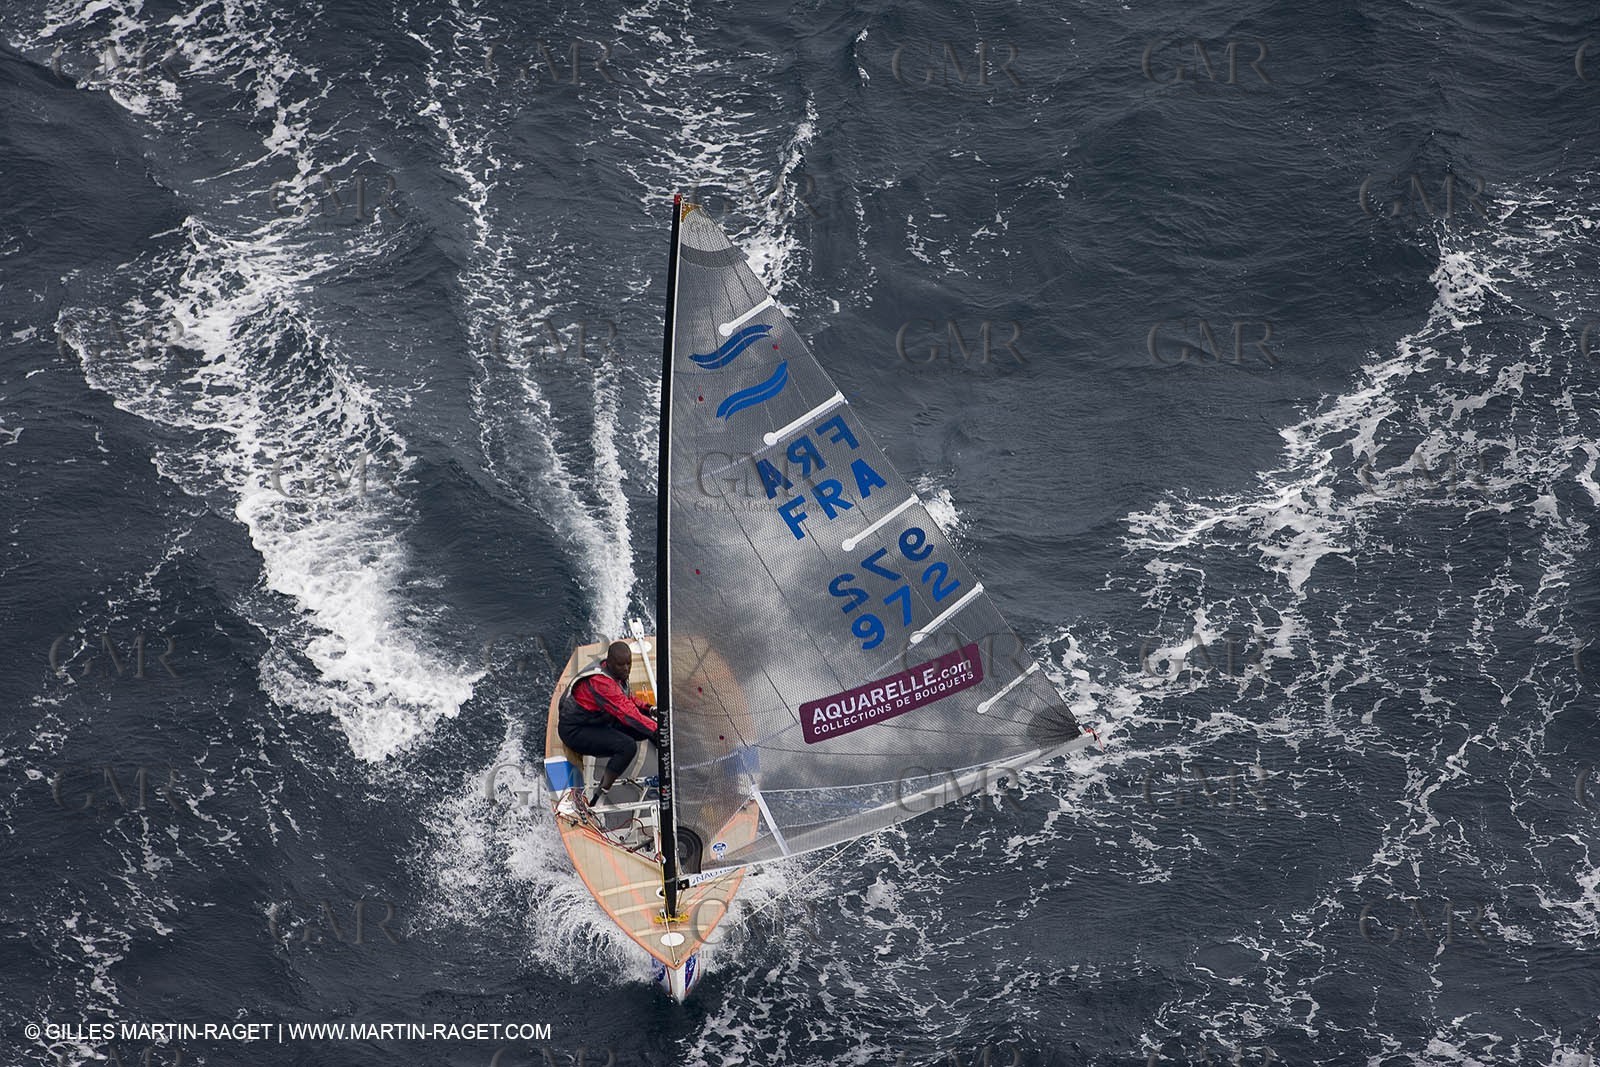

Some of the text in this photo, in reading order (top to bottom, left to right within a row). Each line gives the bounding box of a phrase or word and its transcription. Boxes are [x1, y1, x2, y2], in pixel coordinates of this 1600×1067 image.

[778, 458, 887, 541] FRA
[851, 561, 961, 649] 972
[812, 659, 972, 725] AQUARELLE.com
[813, 671, 974, 735] COLLECTIONS DE BOUQUETS
[660, 710, 670, 748] Holland
